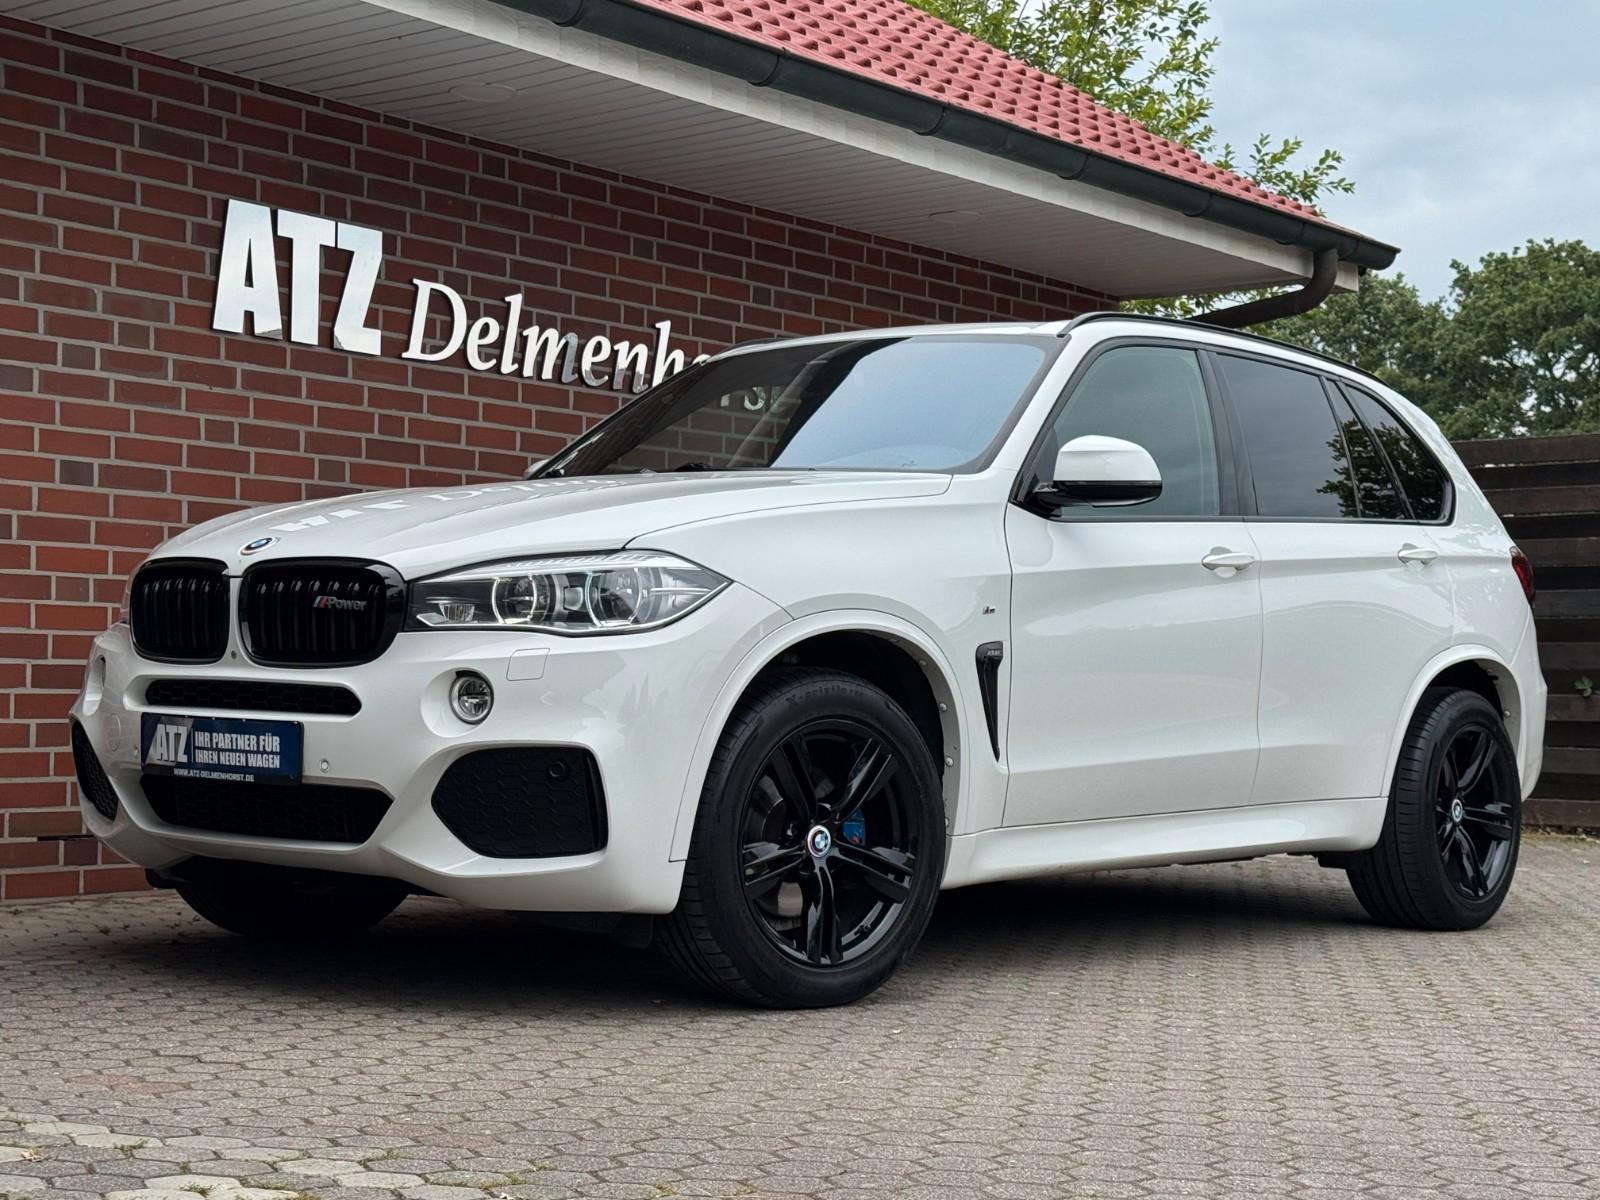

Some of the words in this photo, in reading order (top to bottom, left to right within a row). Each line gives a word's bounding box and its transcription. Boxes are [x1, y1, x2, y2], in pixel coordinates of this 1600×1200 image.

[212, 198, 383, 356] ATZ
[401, 278, 782, 411] Delmenh
[156, 723, 187, 762] ATZ
[195, 731, 211, 748] IHR
[212, 732, 258, 751] PARTNER
[259, 732, 280, 752] FÜR
[195, 749, 219, 764] IHREN
[219, 751, 246, 767] NEUEN
[247, 752, 280, 769] WAGEN
